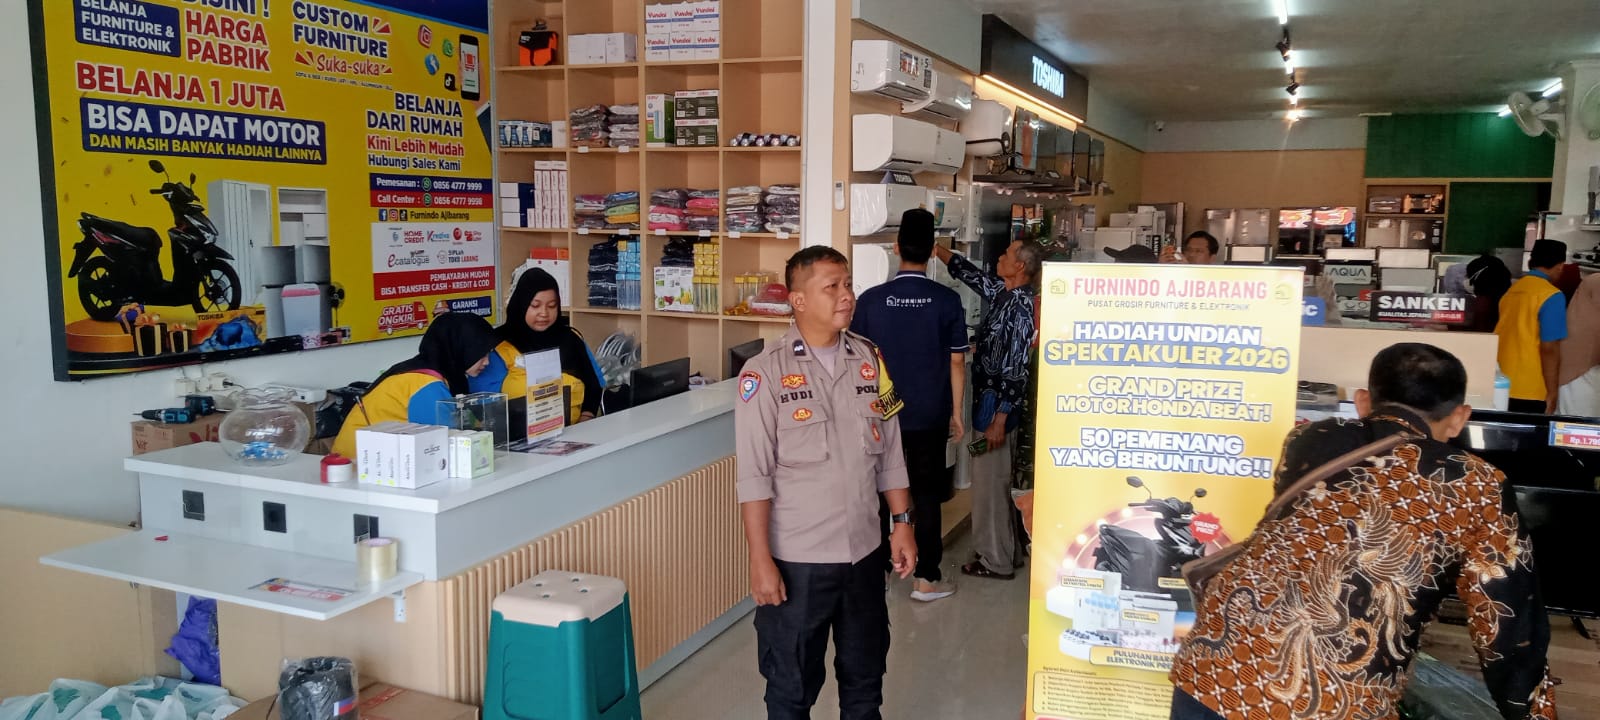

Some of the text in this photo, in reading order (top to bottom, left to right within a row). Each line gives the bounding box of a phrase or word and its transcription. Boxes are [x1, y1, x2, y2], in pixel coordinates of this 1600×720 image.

[81, 0, 147, 18] BELANJA
[293, 1, 369, 33] CUSTOM
[81, 11, 175, 38] FURNITURE &
[185, 10, 268, 46] HARGA
[82, 28, 171, 53] ELEKTRONIK
[294, 25, 388, 58] FURNITURE
[187, 38, 270, 71] PABRIK
[317, 54, 380, 76] Suka-suka
[77, 62, 285, 111] BELANJA 1 JUTA
[1032, 55, 1065, 98] TOSHIBA
[395, 92, 463, 117] BELANJA
[87, 103, 320, 146] BISA DAPAT MOTOR
[367, 110, 463, 137] DARI RUMAH
[90, 134, 322, 161] DAN MASIH BANYAK HADIAH LAINNYA
[367, 135, 465, 156] Kini Lebih Mudah
[368, 154, 461, 171] Hubungi Sales Kami
[376, 178, 416, 188] Pemesanan
[433, 180, 450, 189] 0856
[451, 181, 465, 190] 4777
[467, 182, 483, 191] 9999
[377, 194, 391, 203] Call
[392, 195, 415, 203] Center
[410, 211, 469, 221] Furnindo Ajibarang
[430, 270, 489, 282] PEMBAYARAN MUDAH
[1330, 267, 1367, 277] AQUA
[380, 287, 396, 296] BISA
[397, 284, 430, 294] TRANSFER
[431, 283, 448, 291] CASH
[452, 280, 472, 289] KREDIT
[478, 279, 489, 288] COD
[1074, 278, 1268, 299] FURNINDO AJIBARANG
[382, 304, 413, 316] GRATIS
[452, 299, 478, 309] GARANSI
[1088, 300, 1250, 311] PUSAT GROSIR FURNITURE & ELEKTRONIK
[1378, 295, 1466, 311] SANKEN
[378, 314, 413, 326] ONGKIR
[1074, 323, 1262, 346] HADIAH UNDIAN
[1047, 342, 1289, 370] SPEKTAKULER 2026
[1089, 377, 1243, 401] GRAND PRIZE
[1057, 396, 1272, 422] MOTOR HONDA BEAT!
[1081, 428, 1244, 455] 50 PEMENANG
[1050, 447, 1273, 479] YANG BERUNTUNG!!
[1106, 656, 1155, 668] ELEKTRONIK
[1114, 650, 1152, 660] PULUHAN
